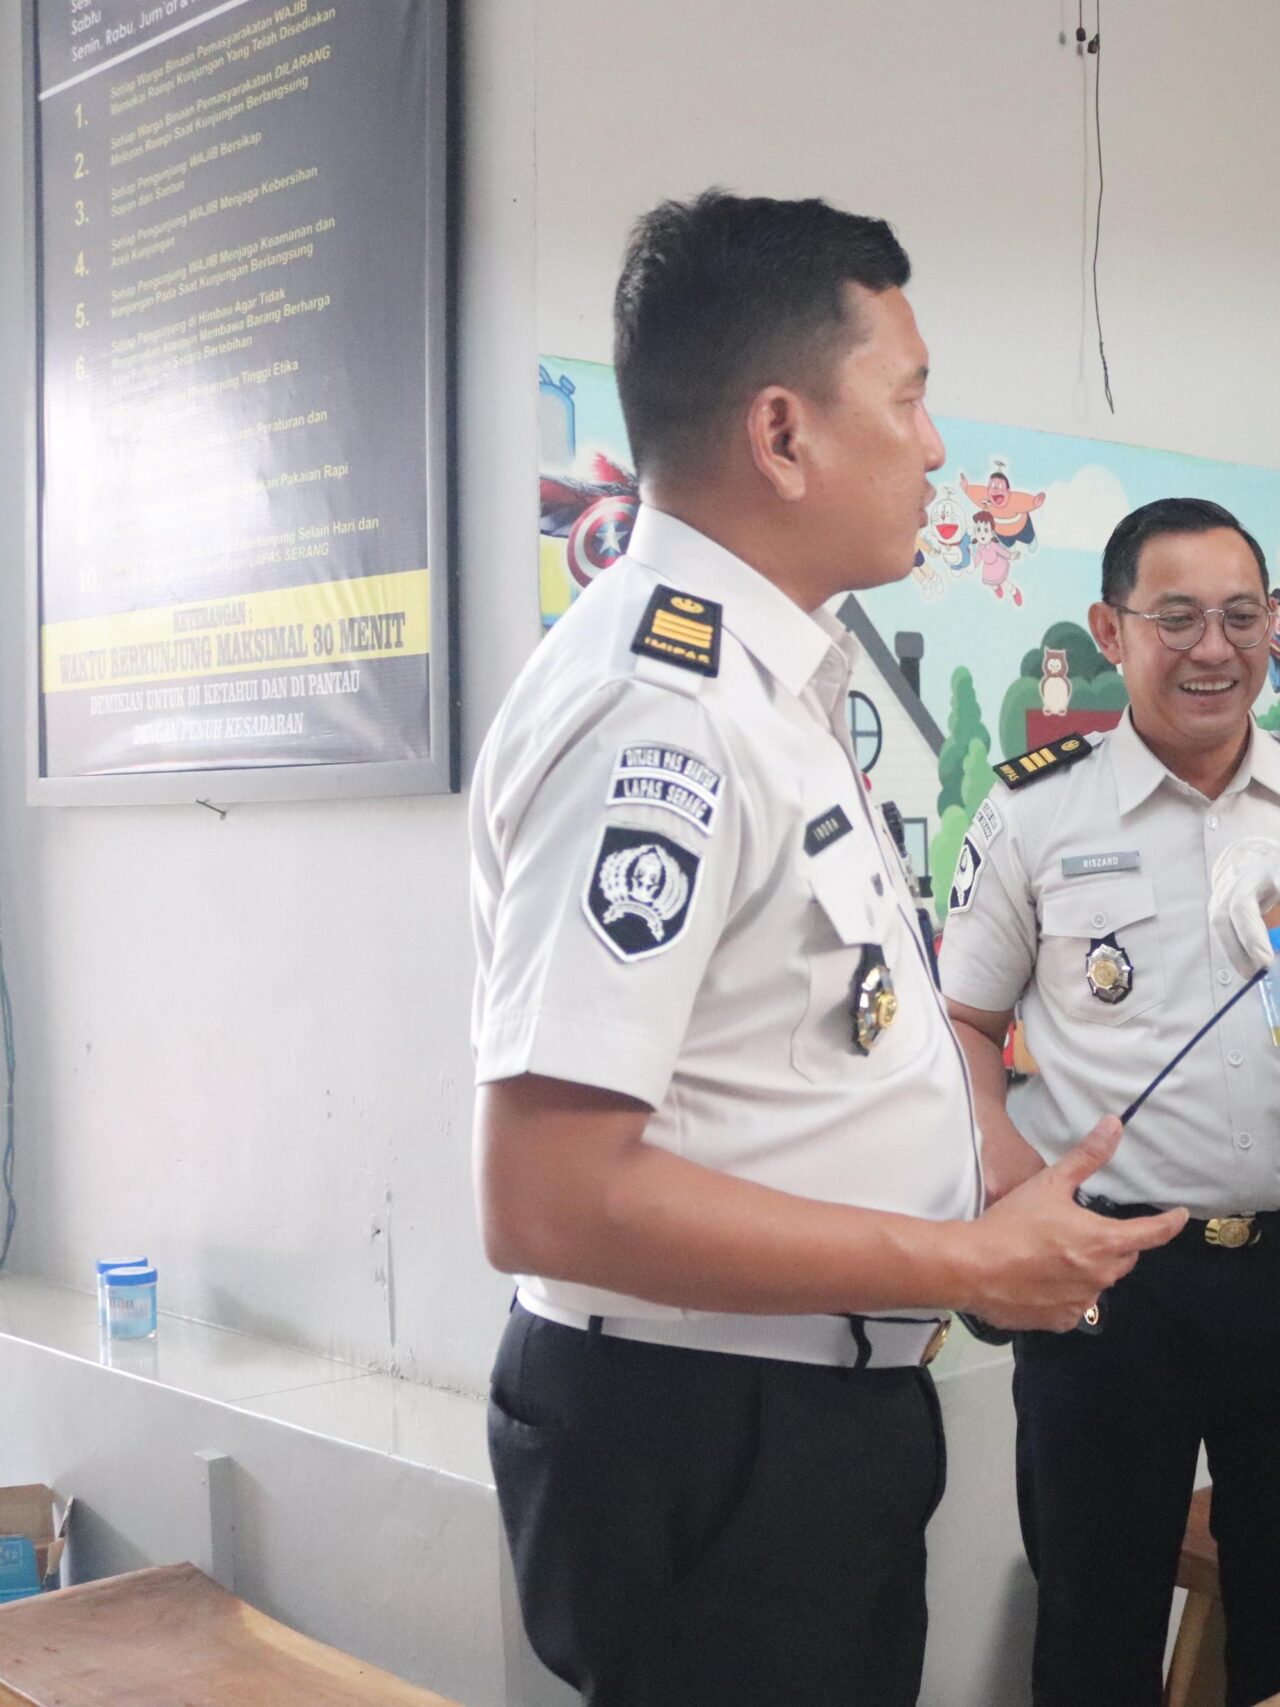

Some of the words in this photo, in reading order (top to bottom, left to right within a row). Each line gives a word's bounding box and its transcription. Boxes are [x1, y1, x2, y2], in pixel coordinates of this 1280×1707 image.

[71, 10, 102, 36] Sabtu
[137, 67, 163, 92] Warga
[165, 52, 195, 77] Binaan
[197, 18, 272, 61] Pemasyarakatan
[274, 1, 307, 25] WAJIB
[148, 79, 174, 102] Rompi
[176, 56, 224, 86] Kunjungan
[226, 44, 249, 65] Yang
[252, 31, 278, 52] Telah
[280, 8, 336, 41] Disediakan
[137, 118, 163, 143] Warga
[165, 103, 195, 128] Binaan
[197, 73, 272, 116] Pemasyarakatan
[274, 45, 331, 79] DILARANG
[74, 103, 89, 128] 1.
[145, 131, 172, 155] Rompi
[174, 121, 194, 140] Saat
[195, 102, 244, 132] Kunjungan
[246, 75, 309, 110] Berlangsung
[74, 152, 90, 180] 2.
[137, 161, 187, 193] Pengunjung
[189, 146, 218, 168] WAJIB
[220, 131, 262, 157] Bersikap
[74, 200, 90, 226] 3.
[137, 213, 187, 244] Pengunjung
[189, 199, 218, 222] WAJIB
[220, 184, 259, 212] Menjaga
[261, 165, 318, 196] Kebersihan
[74, 251, 90, 277] 4.
[137, 266, 187, 294] Pengunjung
[189, 252, 218, 275] WAJIB
[220, 241, 259, 266] Menjaga
[260, 224, 313, 252] Keamanan
[315, 216, 336, 235] dan
[155, 288, 177, 303] Pada
[178, 278, 198, 296] Saat
[199, 261, 249, 291] Kunjungan
[251, 242, 314, 274] Berlangsung
[74, 302, 90, 329] 5.
[198, 306, 233, 324] Himbau
[235, 296, 257, 315] Agar
[259, 287, 286, 305] Tidak
[199, 319, 244, 342] Membawa
[246, 307, 281, 330] Barang
[283, 293, 331, 318] Berharga
[204, 335, 252, 359] Berlebihan
[242, 367, 271, 387] Tinggi
[273, 359, 299, 377] Etika
[256, 415, 305, 435] Peraturan
[307, 409, 328, 425] dan
[281, 468, 321, 486] Pakaian
[323, 461, 349, 479] Rapi
[298, 524, 330, 540] Selain
[333, 519, 356, 534] Hari
[358, 515, 379, 530] dan
[284, 543, 329, 561] SERANG
[173, 601, 246, 633] KETERANGAN
[59, 649, 107, 685] WAKTU
[110, 635, 212, 679] BERKUNJUNG
[216, 623, 308, 668] MAKSIMAL
[313, 622, 334, 657] 30
[339, 611, 406, 653] MENIT
[90, 693, 144, 715] DEMIKIAN
[146, 687, 184, 710] UNTUK
[187, 685, 201, 706] DI
[204, 680, 260, 706] KETAHUI
[262, 677, 287, 699] DAN
[290, 675, 306, 695] DI
[308, 670, 360, 695] PANTAU
[225, 712, 304, 739] KESADARAN
[664, 752, 683, 771] PAS
[624, 779, 662, 799] LAPAS
[667, 785, 707, 819] SERANG
[1083, 856, 1119, 868] RISZARD
